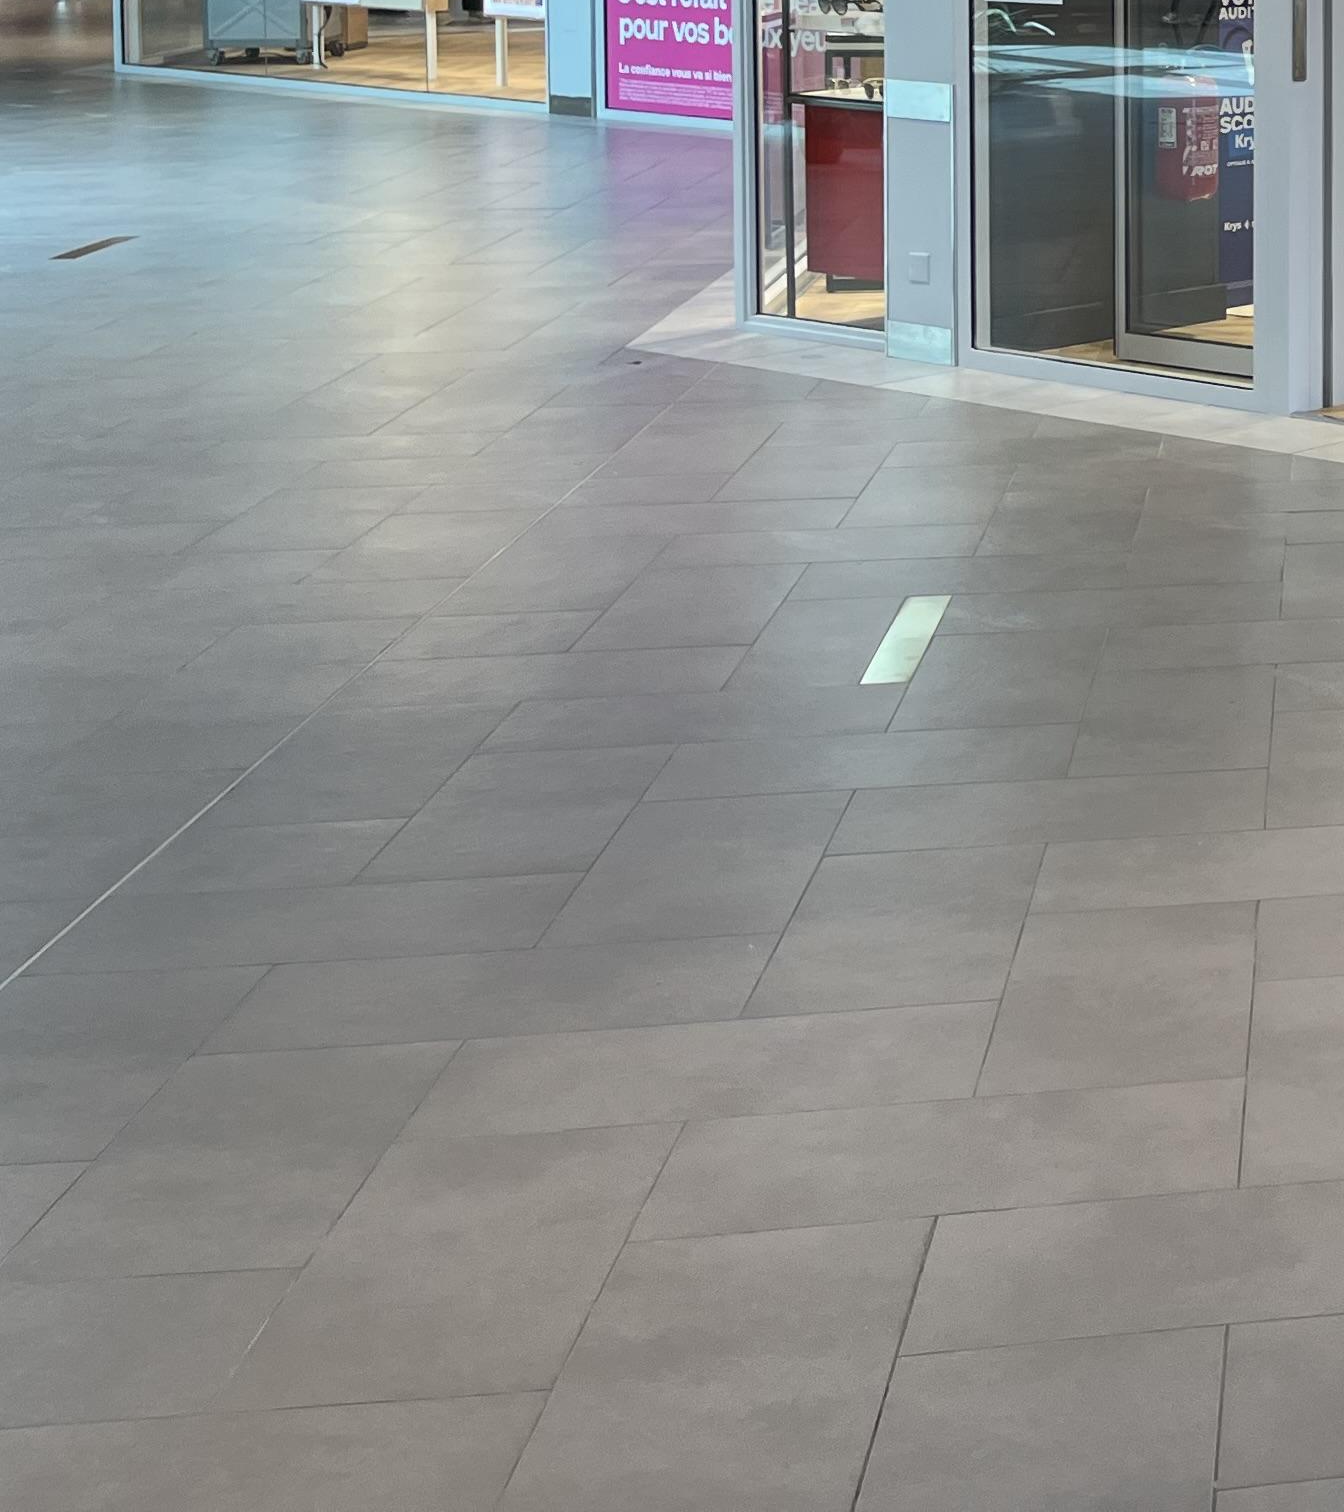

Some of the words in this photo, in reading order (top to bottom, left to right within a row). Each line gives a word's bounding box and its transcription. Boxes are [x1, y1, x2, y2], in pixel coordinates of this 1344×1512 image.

[1218, 6, 1255, 21] AUDI
[618, 17, 669, 46] pour
[671, 19, 710, 45] vos
[618, 61, 630, 74] La
[630, 63, 671, 78] confiance
[1219, 96, 1255, 116] AUD
[1219, 114, 1255, 134] SCO
[1234, 133, 1255, 151] Kry
[1223, 221, 1242, 232] Krys
